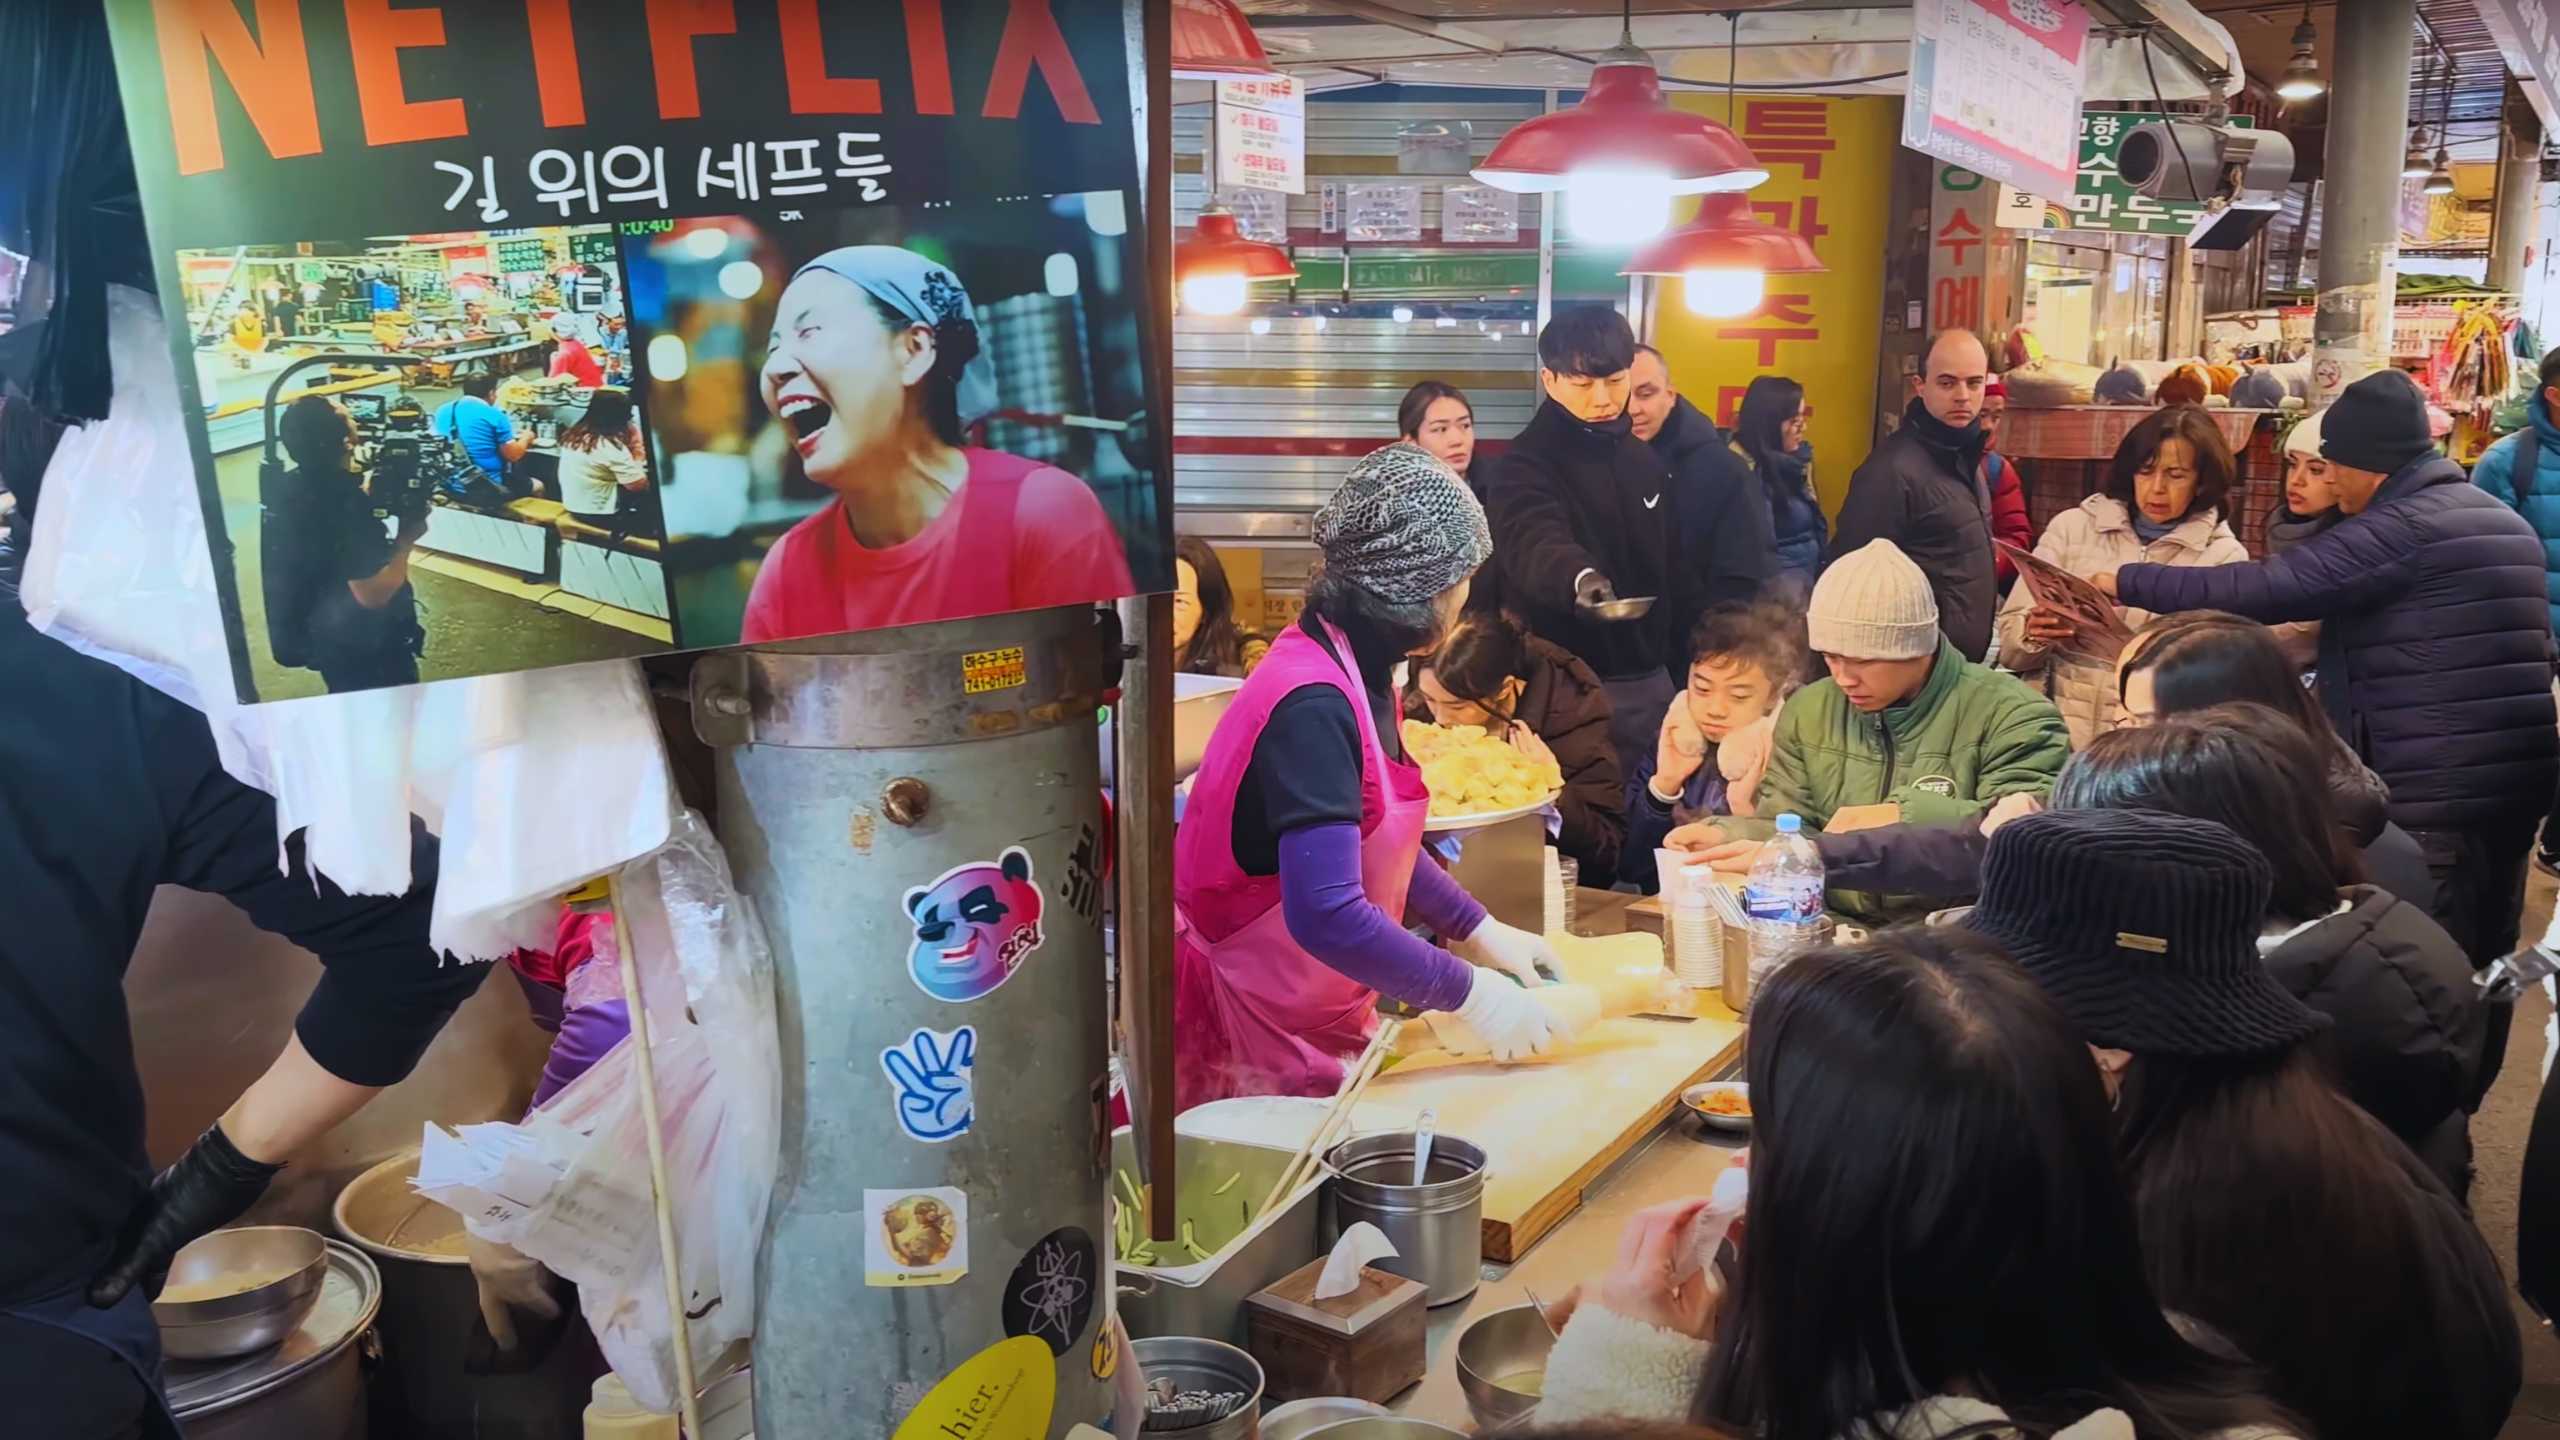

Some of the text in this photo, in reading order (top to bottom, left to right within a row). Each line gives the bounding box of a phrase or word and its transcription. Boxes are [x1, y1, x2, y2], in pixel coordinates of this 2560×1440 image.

[433, 132, 893, 224] 길 위의 세프들
[940, 1383, 1000, 1440] hier.
